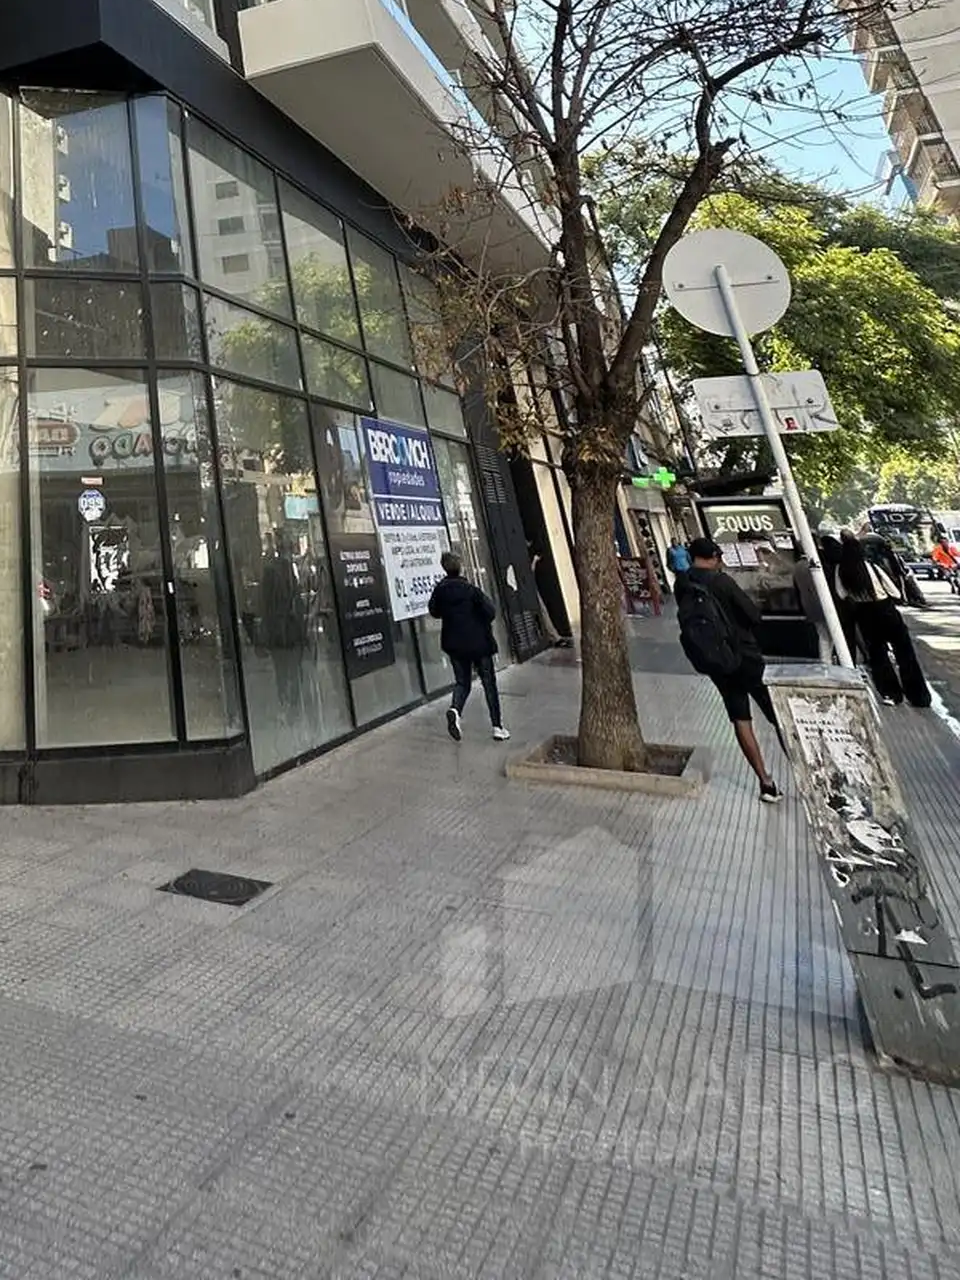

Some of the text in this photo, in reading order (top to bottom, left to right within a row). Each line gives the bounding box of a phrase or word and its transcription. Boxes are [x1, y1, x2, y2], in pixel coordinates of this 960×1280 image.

[367, 428, 431, 471] BERCOVICH
[716, 514, 774, 532] EQUUS
[881, 513, 917, 522] 107
